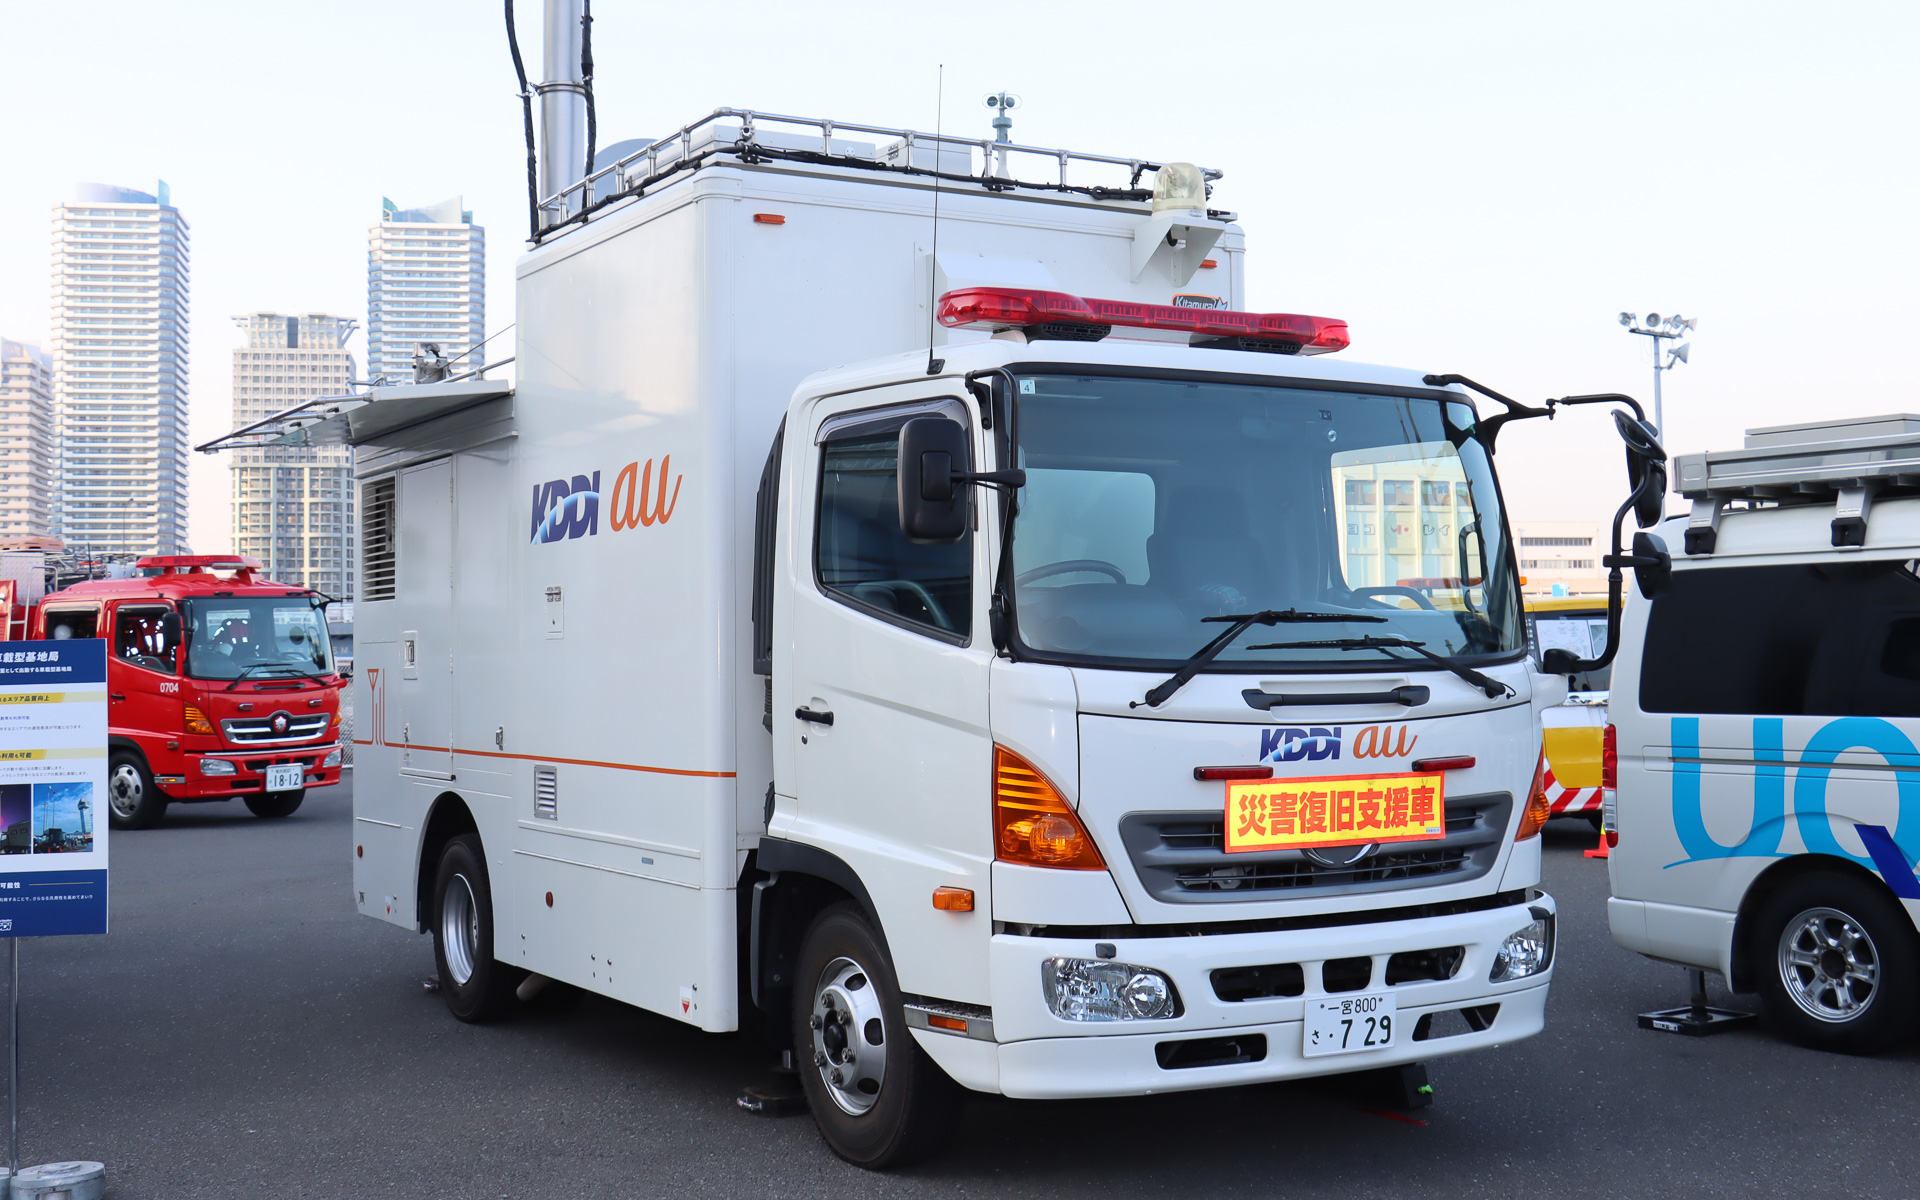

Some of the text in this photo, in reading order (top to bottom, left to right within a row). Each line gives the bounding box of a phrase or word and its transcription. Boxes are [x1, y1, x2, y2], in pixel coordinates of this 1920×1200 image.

[1175, 296, 1214, 309] Kitamura
[530, 454, 683, 546] KDDI au
[160, 682, 179, 693] 0704
[1259, 725, 1418, 763] KDDI au
[274, 773, 299, 788] 18-12
[1237, 785, 1435, 838] 災害復旧支援車
[1327, 997, 1377, 1015] 一宮800
[1311, 1029, 1320, 1045] さ
